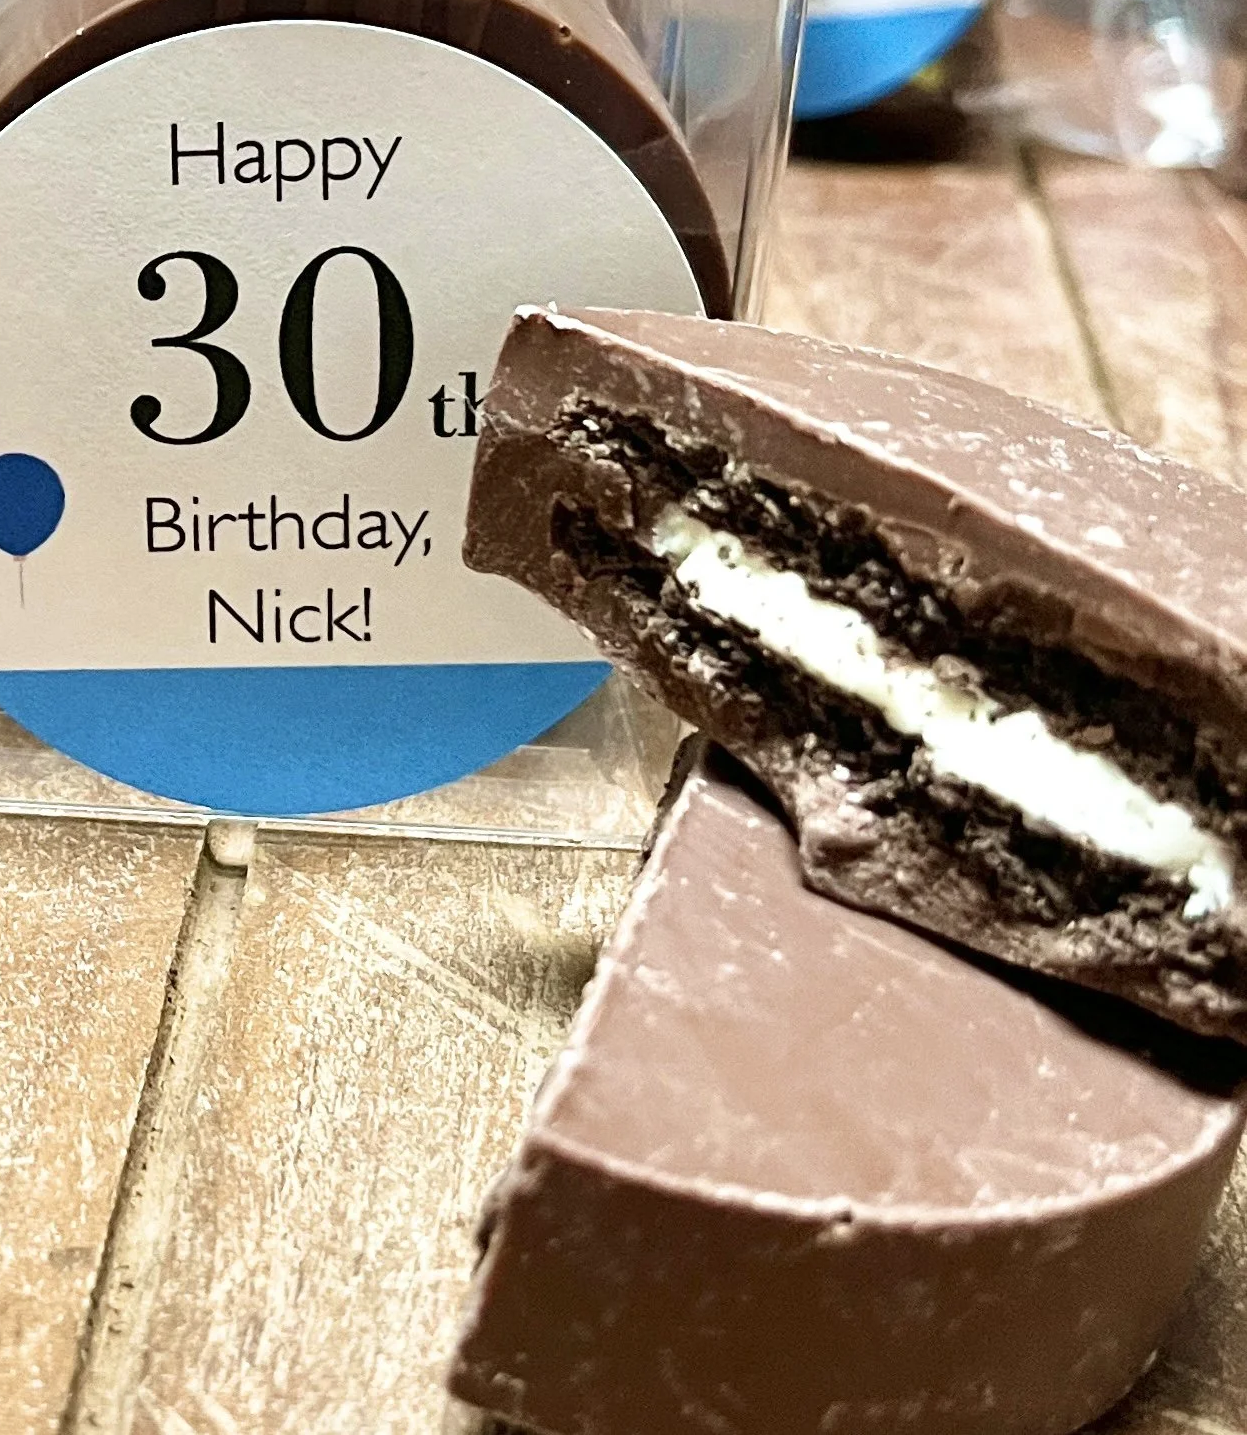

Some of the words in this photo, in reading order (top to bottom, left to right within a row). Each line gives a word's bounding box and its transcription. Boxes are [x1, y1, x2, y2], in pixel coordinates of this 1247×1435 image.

[170, 121, 403, 203] Happy
[146, 493, 432, 567] Birthday,
[208, 587, 372, 644] Nick!
